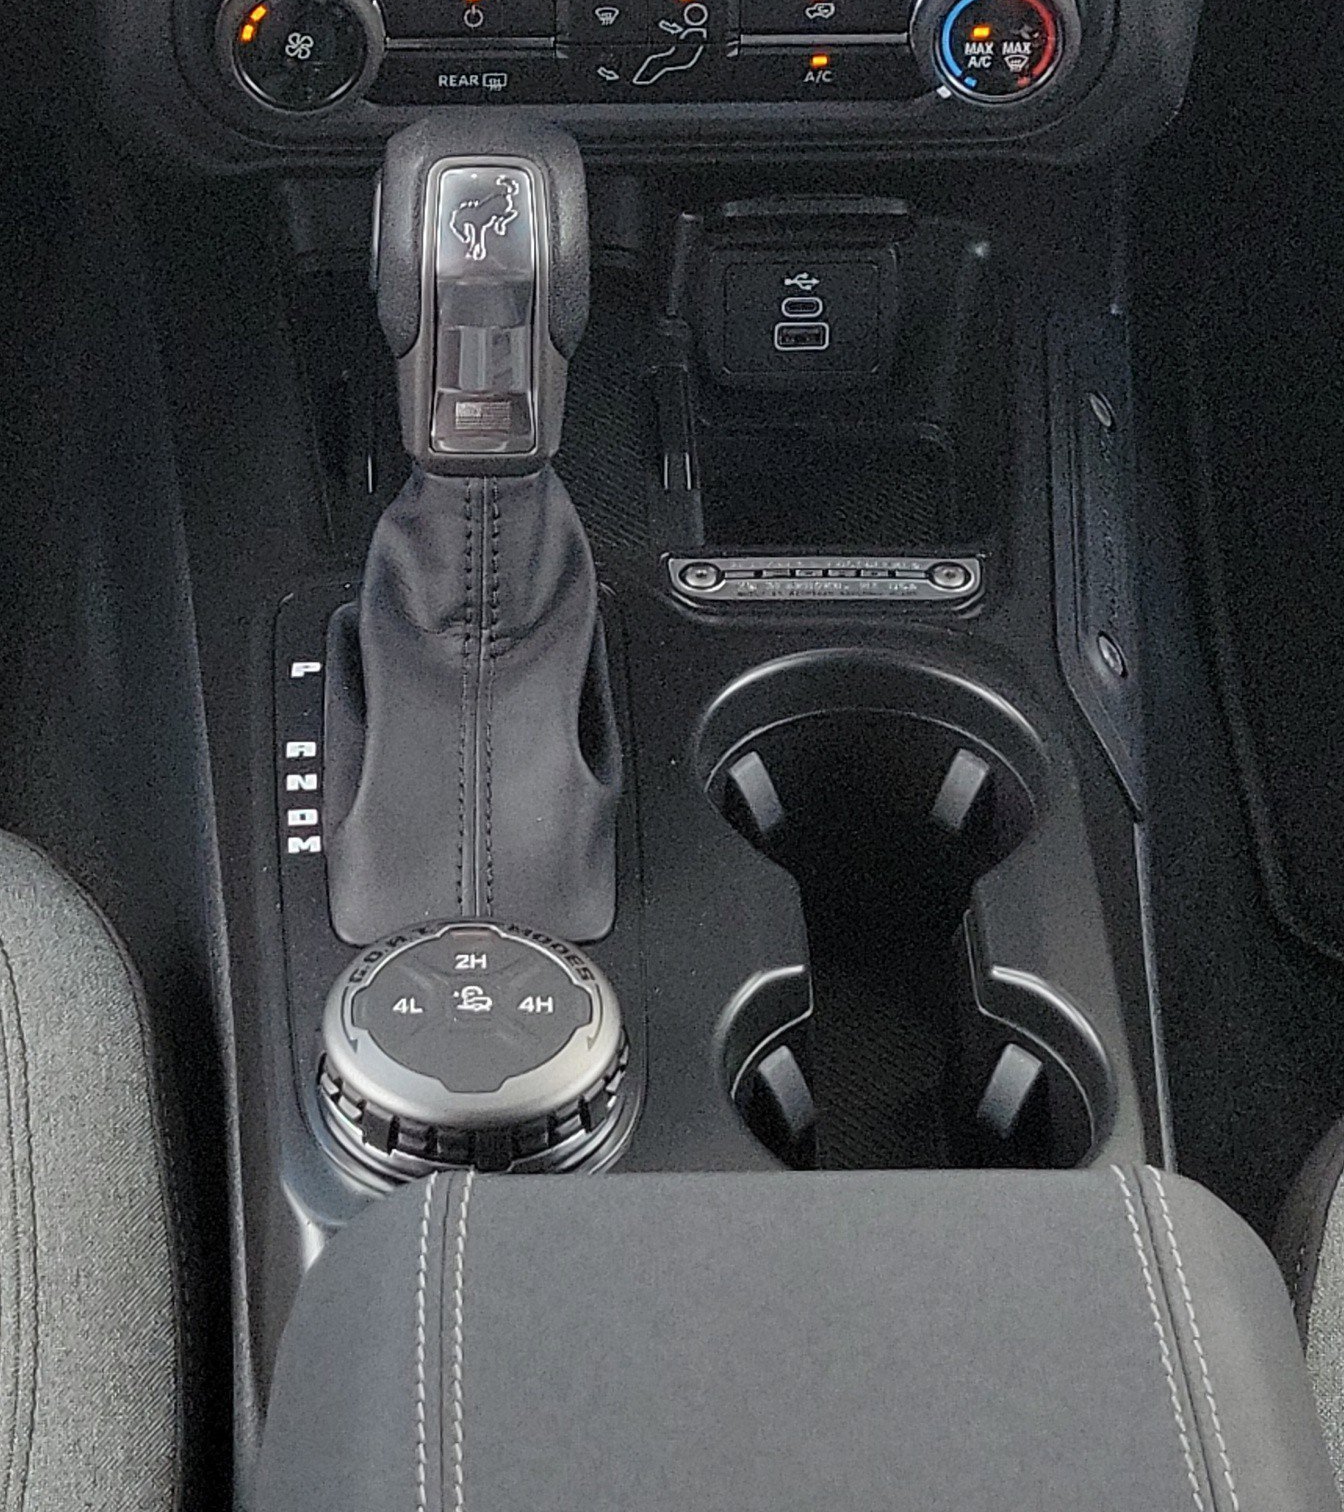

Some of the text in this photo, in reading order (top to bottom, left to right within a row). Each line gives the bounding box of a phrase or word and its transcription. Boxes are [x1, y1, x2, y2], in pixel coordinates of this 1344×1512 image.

[964, 41, 1032, 55] MAX MAX
[967, 55, 992, 68] A/C
[437, 74, 479, 87] REAR
[803, 69, 833, 83] A/C
[290, 661, 322, 678] P
[286, 774, 318, 791] N
[288, 835, 322, 854] M
[506, 922, 596, 982] MODES
[454, 953, 488, 970] 2H
[392, 997, 424, 1014] 4L
[517, 996, 554, 1013] 4H
